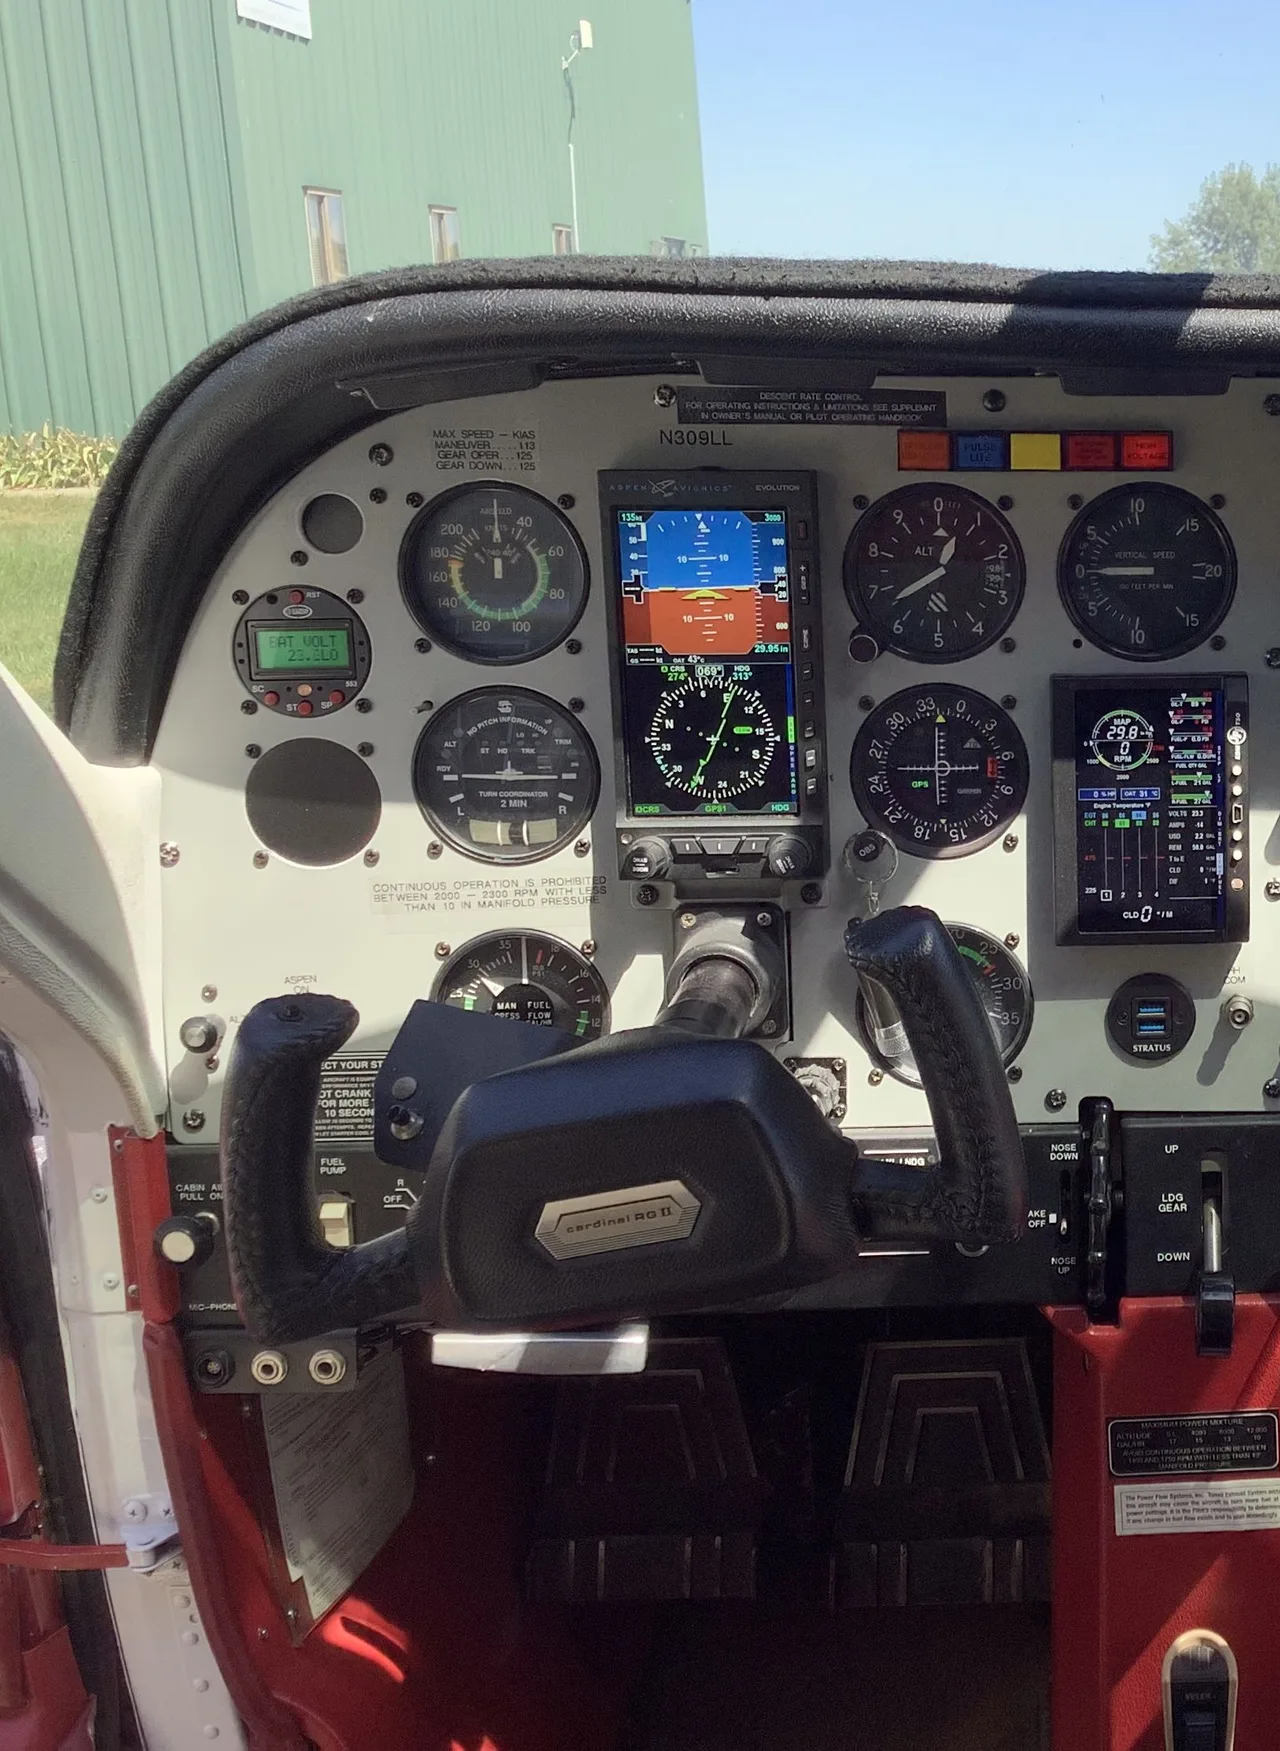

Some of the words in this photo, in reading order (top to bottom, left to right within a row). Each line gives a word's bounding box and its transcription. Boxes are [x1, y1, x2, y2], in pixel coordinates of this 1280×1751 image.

[760, 392, 796, 400] DESCENT
[825, 393, 862, 401] CONTROL
[712, 412, 751, 420] OWNER'S
[806, 413, 827, 421] PILOT
[831, 413, 875, 421] OPERATING
[879, 414, 922, 422] HANDBOOK
[433, 430, 456, 438] MAX
[462, 430, 494, 439] SPEED
[512, 431, 535, 439] KIAS
[659, 430, 733, 446] N309LL
[964, 442, 996, 452] PULSE
[438, 451, 468, 460] GEAR
[436, 461, 465, 470] GEAR
[441, 525, 463, 535] 200
[549, 547, 564, 556] 60
[915, 546, 934, 556] ALT
[1114, 551, 1147, 559] VERTICAL
[1153, 551, 1175, 559] SPEED
[1205, 565, 1221, 577] 20
[472, 621, 490, 631] 120
[512, 622, 531, 632] 100
[303, 635, 336, 648] VOLT
[467, 728, 478, 736] NO
[478, 717, 498, 730] PITCH
[500, 717, 548, 735] INFORMATION
[1114, 718, 1131, 726] MAP
[1107, 726, 1138, 740] 29.8
[1114, 755, 1132, 763] RPM
[373, 882, 447, 892] CONTINUOUS
[454, 879, 518, 890] OPERATION
[525, 879, 534, 887] IS
[541, 876, 606, 886] PROHIBITED
[374, 893, 427, 902] BETWEEN
[434, 891, 460, 900] 2000
[482, 890, 508, 899] 2300
[514, 888, 538, 897] RPM
[545, 887, 572, 896] WITH
[579, 886, 607, 895] LESS
[405, 903, 435, 911] THAN
[444, 902, 455, 910] 10
[461, 901, 471, 909] IN
[478, 898, 535, 908] MANIFOLD
[541, 896, 599, 906] PRESSURE
[1132, 1043, 1172, 1053] STRATUS
[335, 1089, 371, 1098] CRANK
[339, 1099, 369, 1108] MORE
[1165, 1145, 1178, 1153] UP
[1050, 1152, 1078, 1160] DOWN
[320, 1166, 346, 1174] PUMP
[1162, 1194, 1183, 1202] LDG
[1158, 1204, 1187, 1212] GEAR
[566, 1215, 631, 1235] cardinal
[635, 1210, 657, 1223] RG
[1157, 1253, 1190, 1262] DOWN
